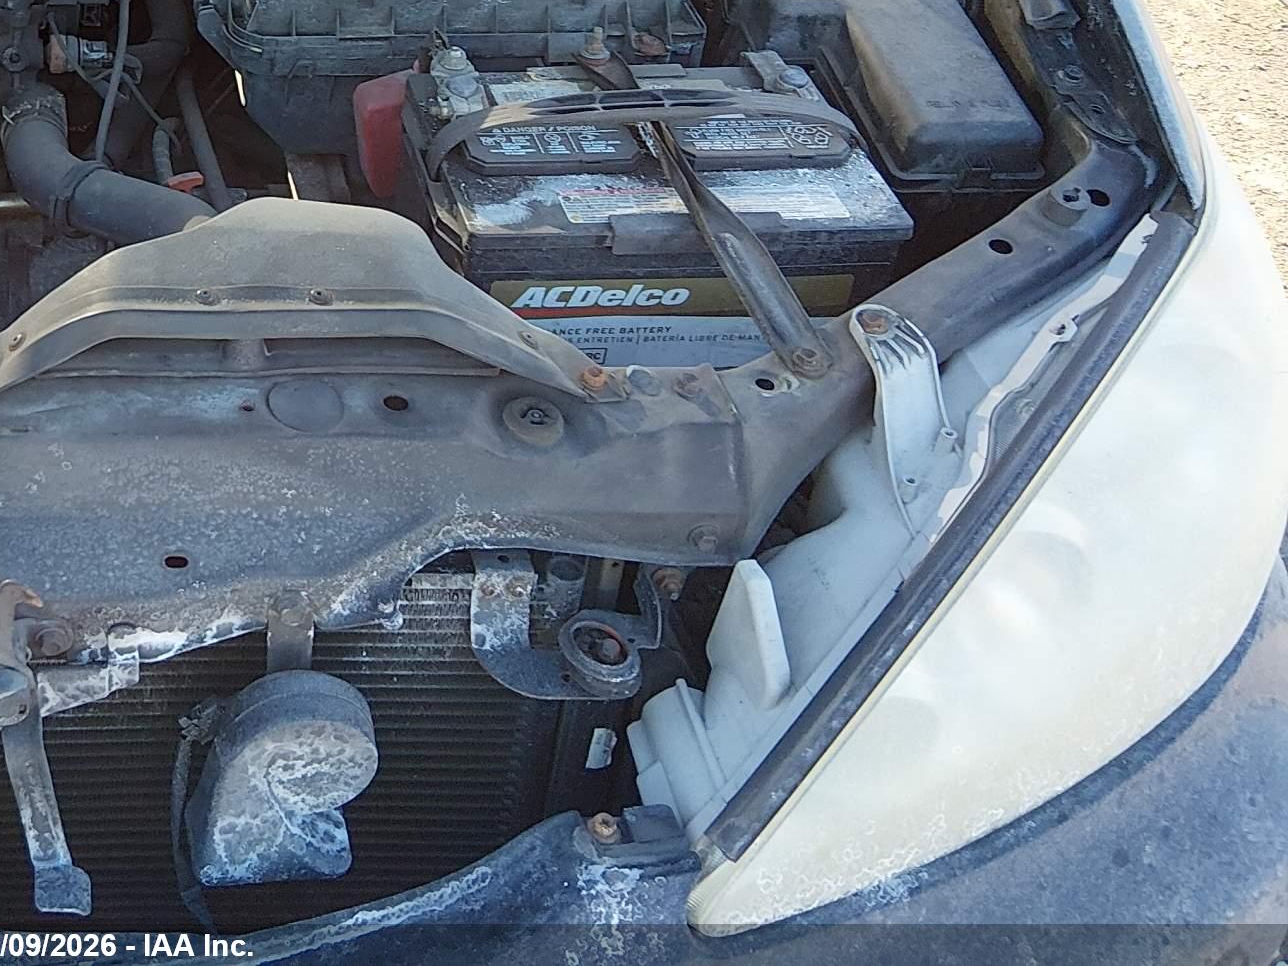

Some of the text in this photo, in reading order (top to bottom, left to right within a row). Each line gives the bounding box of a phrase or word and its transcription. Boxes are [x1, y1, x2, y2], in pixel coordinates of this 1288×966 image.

[556, 124, 597, 132] POISON
[510, 284, 691, 308] ACDelco
[585, 327, 616, 335] FREE
[619, 326, 672, 334] BATTERY
[577, 336, 633, 344] ENTRETIEN
